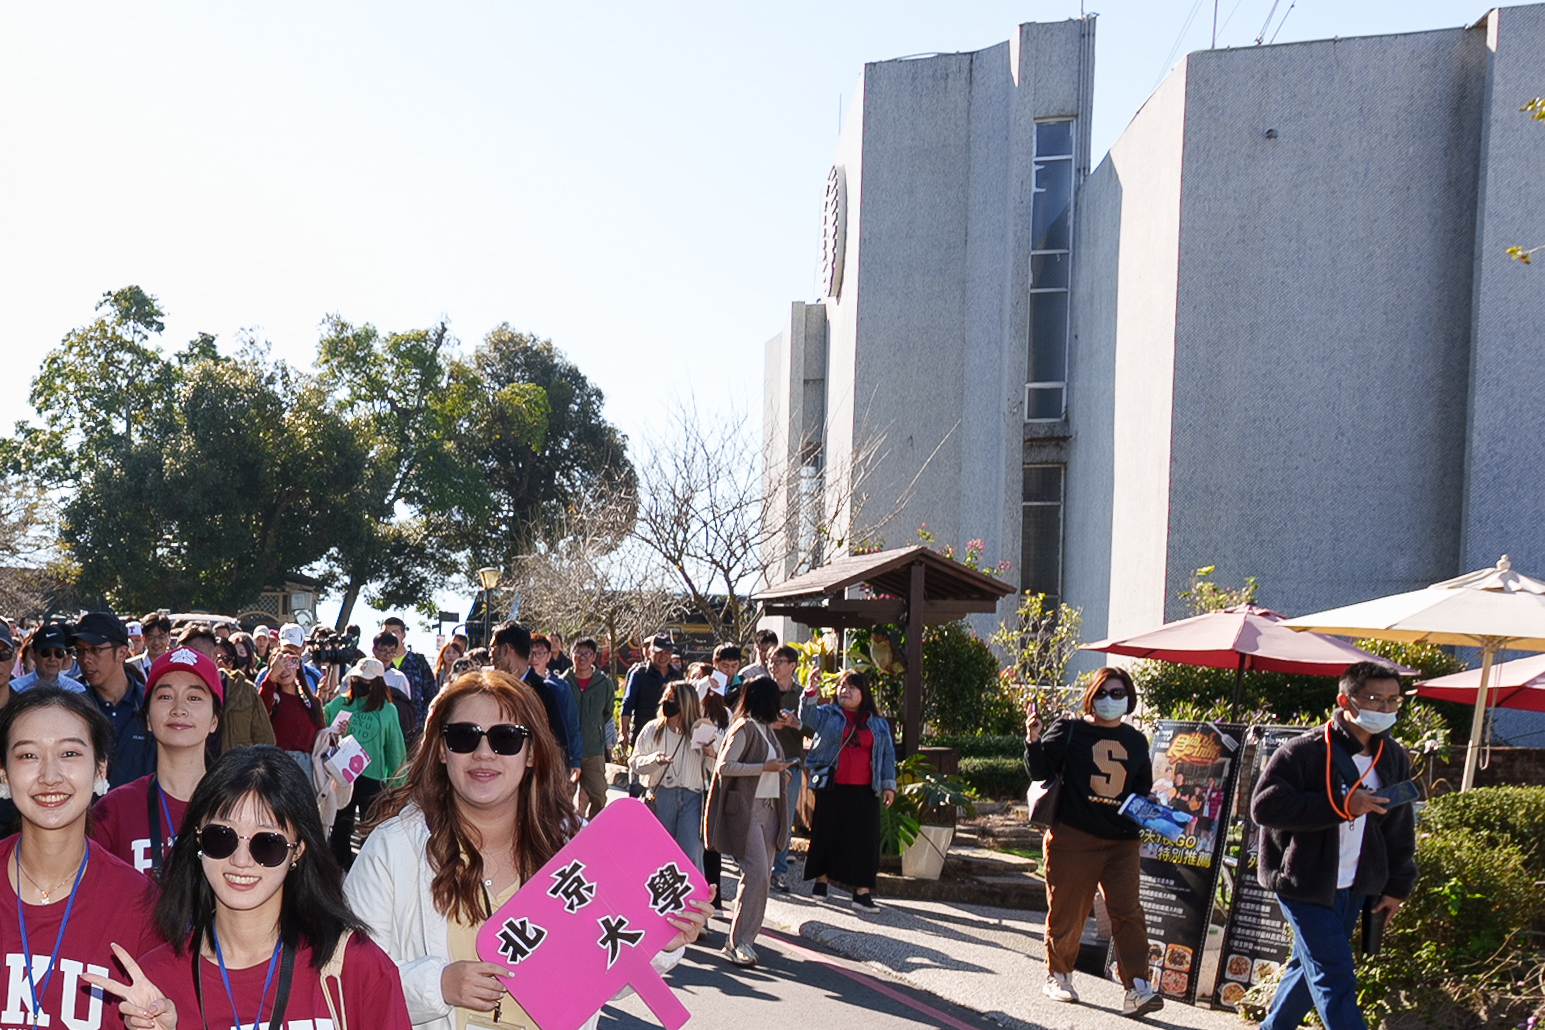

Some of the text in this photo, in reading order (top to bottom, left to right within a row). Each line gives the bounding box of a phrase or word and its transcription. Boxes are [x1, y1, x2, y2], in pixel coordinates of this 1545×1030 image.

[1090, 739, 1128, 798] S
[495, 859, 597, 964] 北京
[596, 861, 695, 970] 大學
